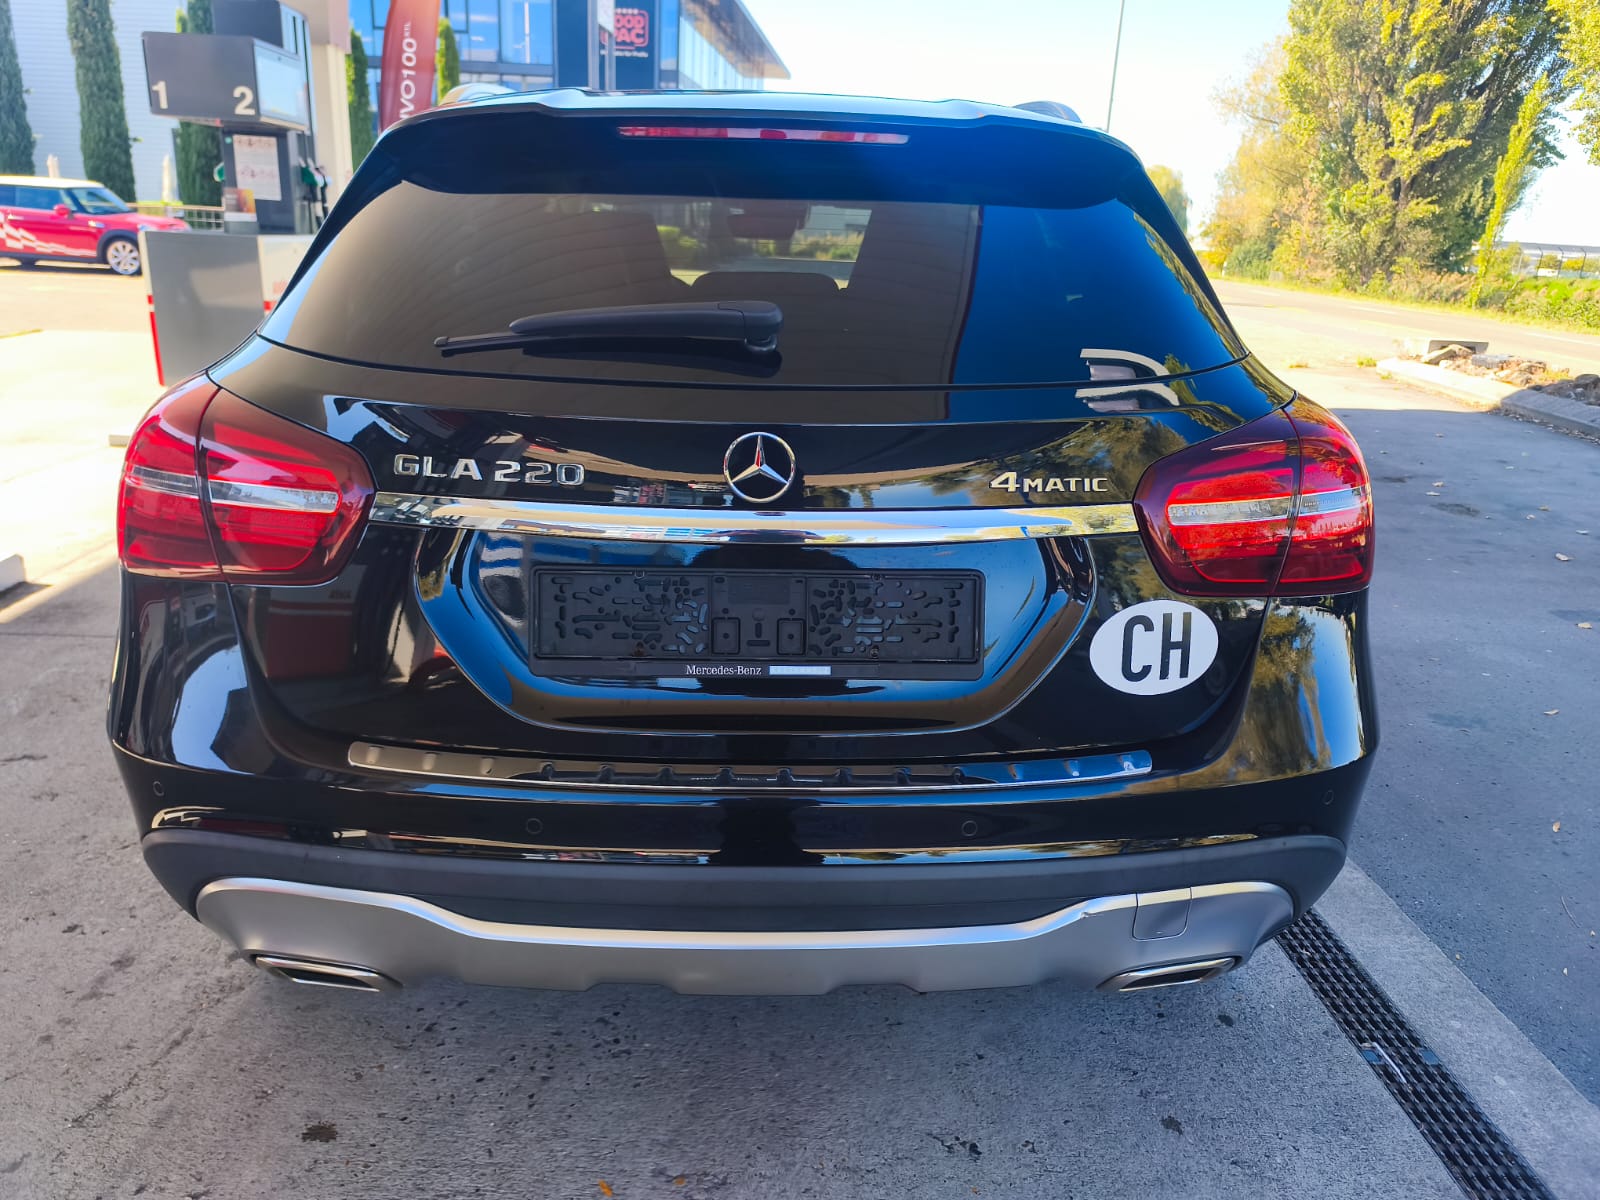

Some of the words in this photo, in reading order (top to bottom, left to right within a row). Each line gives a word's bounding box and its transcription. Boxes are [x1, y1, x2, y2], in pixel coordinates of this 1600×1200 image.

[614, 14, 645, 29] OOD
[614, 27, 645, 45] AC
[152, 81, 169, 110] 1
[232, 86, 256, 116] 2
[393, 453, 483, 481] GLA
[493, 459, 585, 486] 220
[989, 471, 1109, 493] 4MATIC
[1121, 611, 1192, 683] CH
[685, 664, 762, 676] Mercedes-Benz
